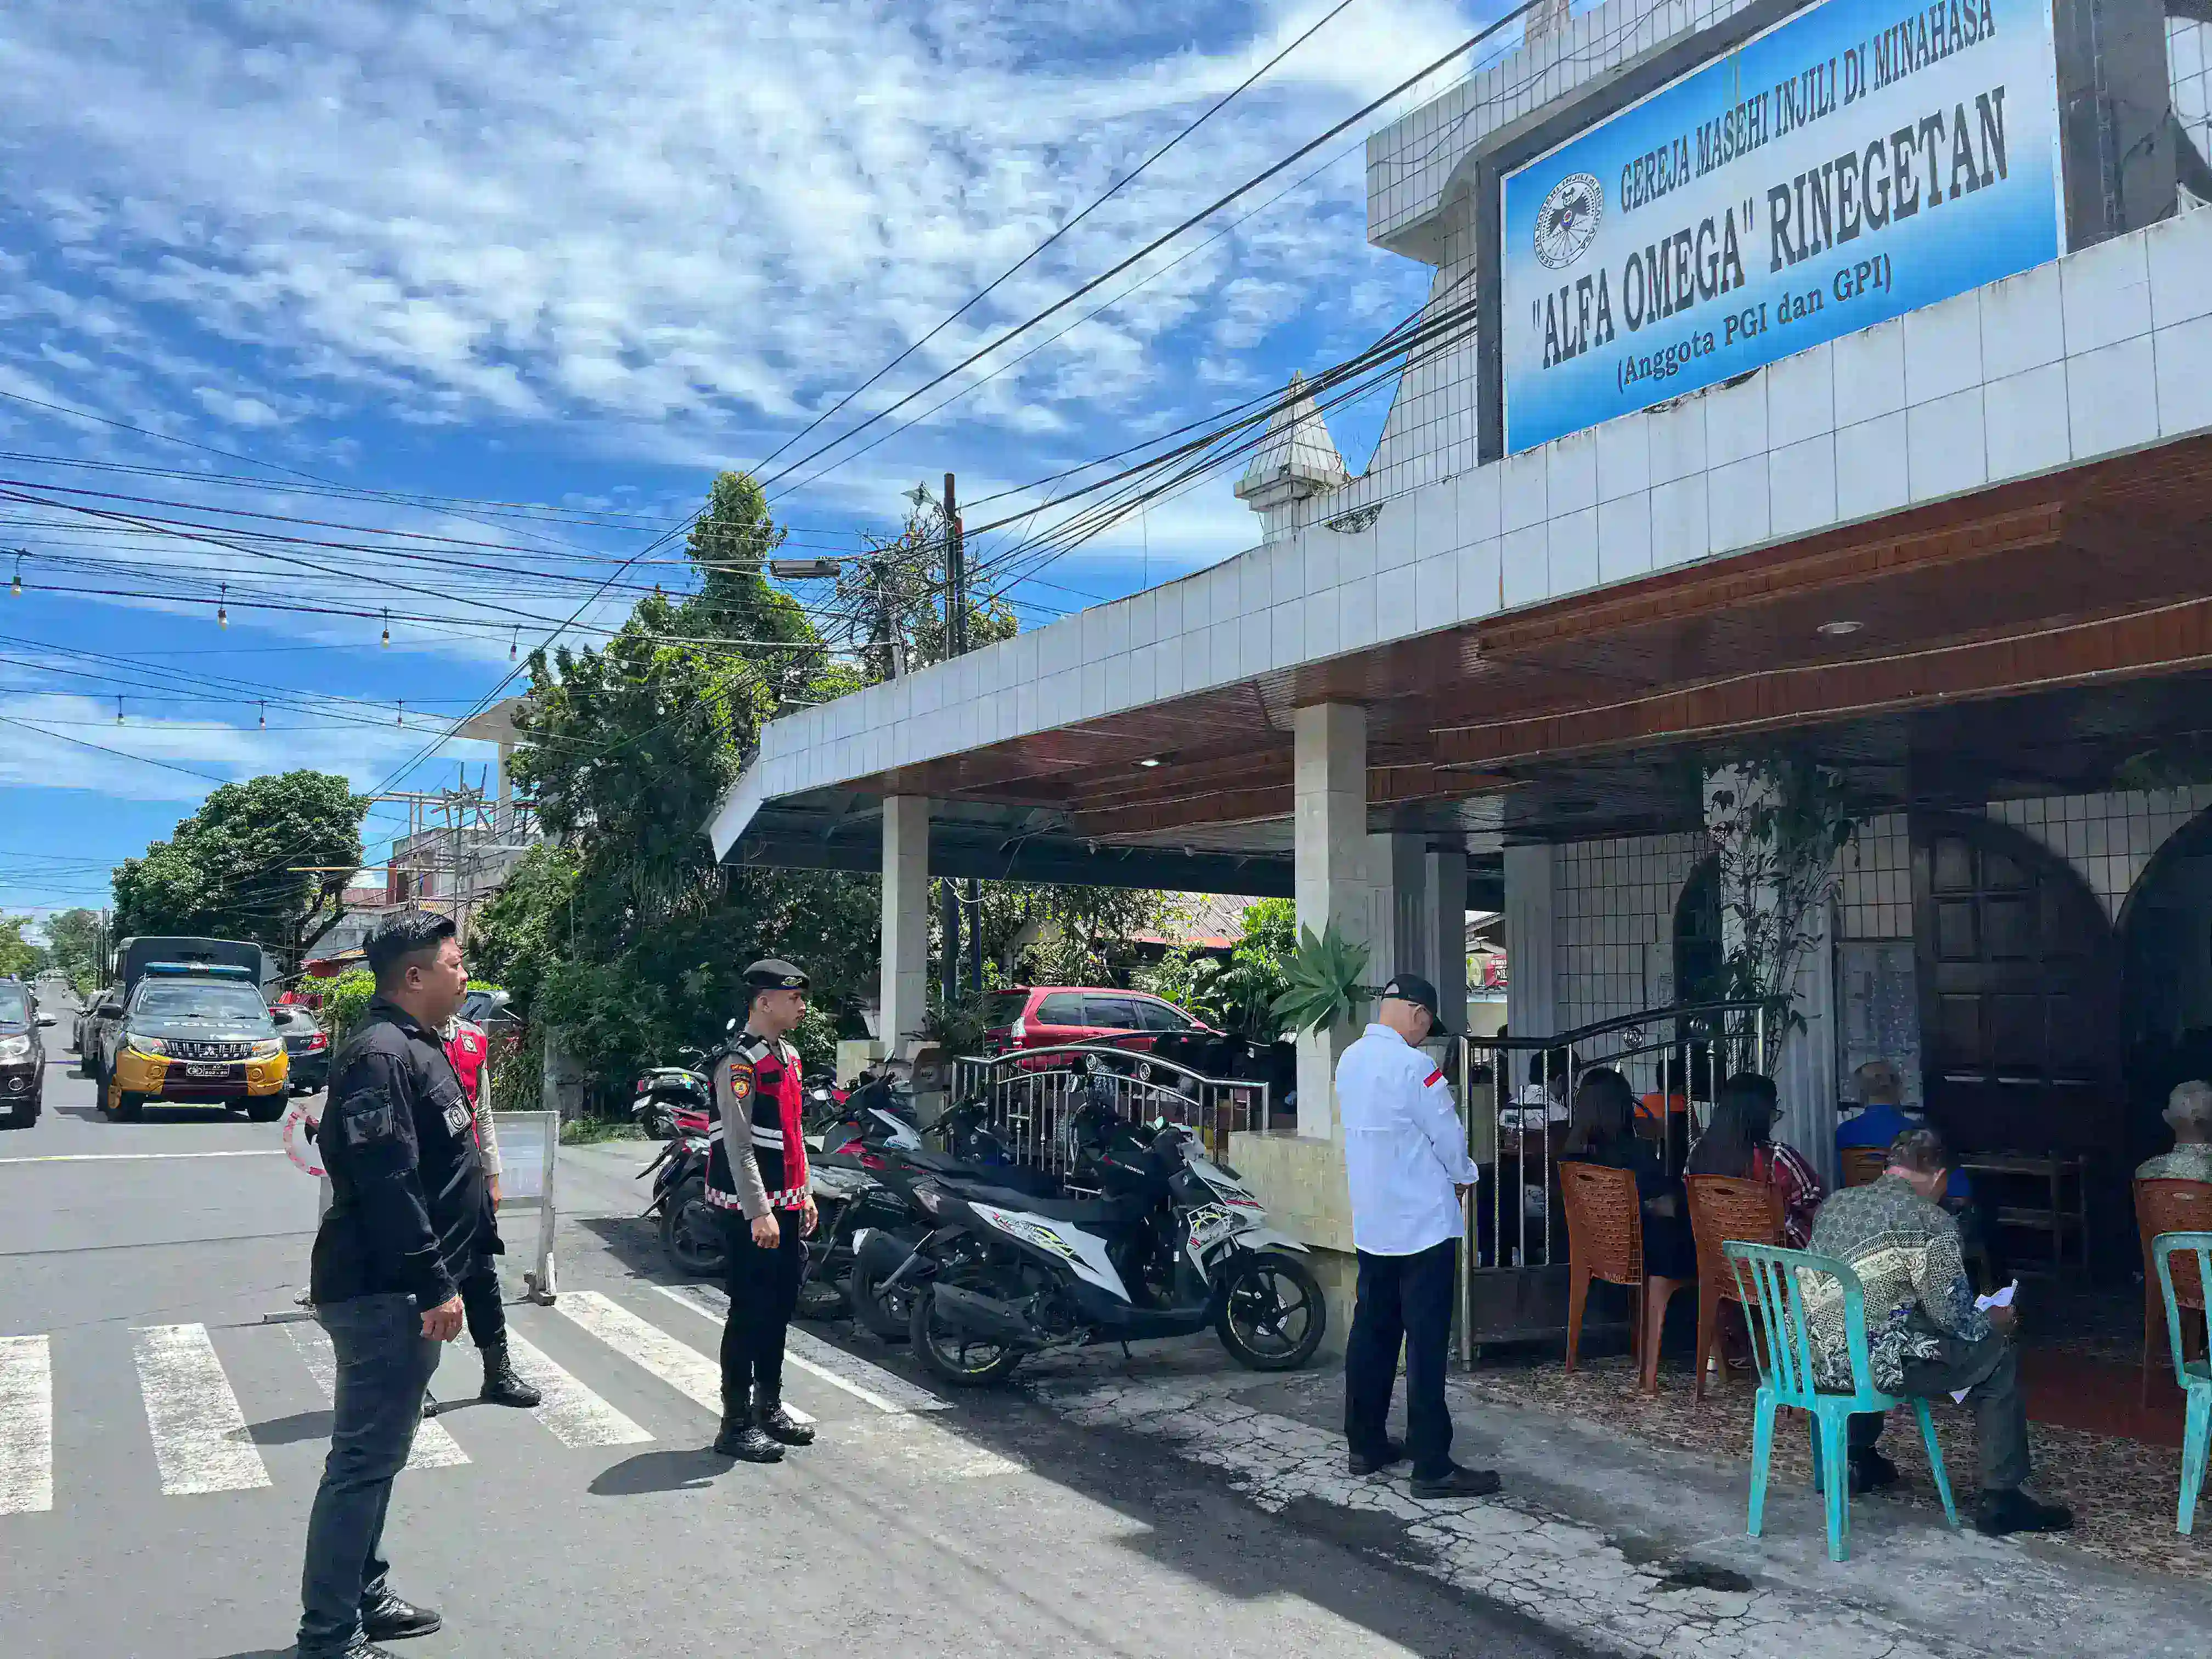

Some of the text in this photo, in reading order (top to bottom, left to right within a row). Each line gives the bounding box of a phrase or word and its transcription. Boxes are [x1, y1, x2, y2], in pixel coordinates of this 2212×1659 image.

[1621, 0, 1996, 213] GEREJA MASEHI INJILI DI MINAHASA
[1533, 84, 2007, 369] "ALFA OMEGA" RINEGETAN
[1618, 252, 1891, 394] (Anggota PGI dan GPI)
